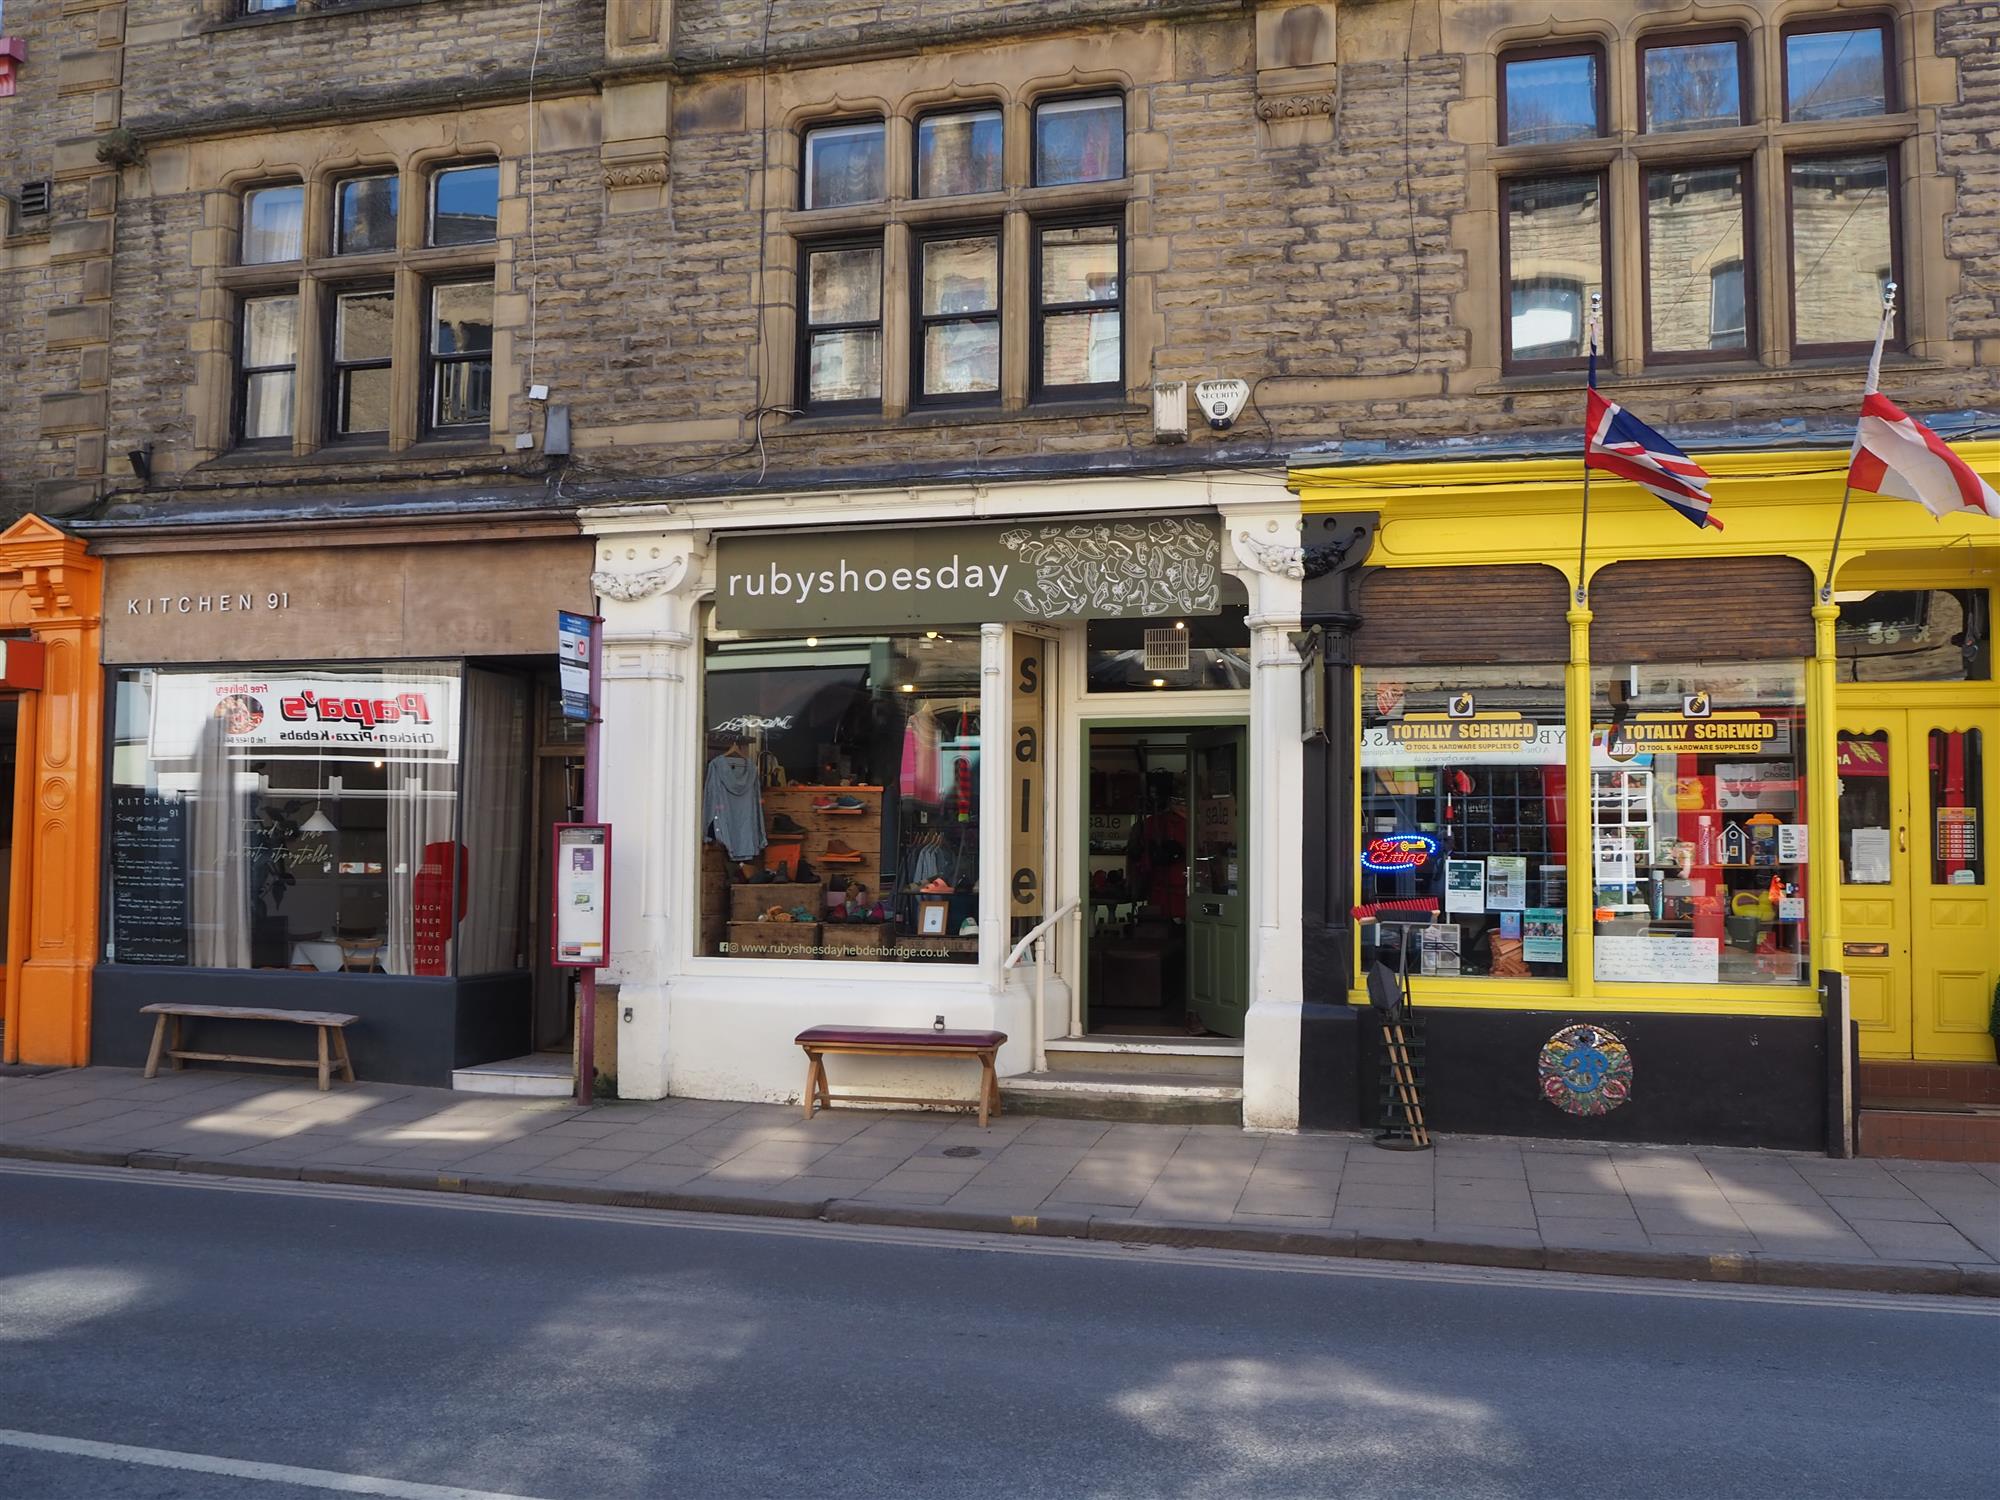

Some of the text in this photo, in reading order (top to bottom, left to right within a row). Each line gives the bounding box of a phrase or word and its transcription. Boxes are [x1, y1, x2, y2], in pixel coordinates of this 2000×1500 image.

[728, 554, 1009, 603] rubyshoesday
[127, 592, 290, 615] KITCHEN 91
[1392, 723, 1453, 739] TOTALLY
[1459, 723, 1534, 738] SCREWED
[1624, 723, 1774, 740] TOTALLY SCREWED
[1011, 656, 1038, 905] sale
[117, 797, 180, 806] KITCHEN
[169, 809, 179, 817] 91
[1369, 839, 1399, 853] Key
[1371, 852, 1428, 865] Cutting
[741, 942, 950, 959] www.rubyshoesdayhebdenbridge.co.uk
